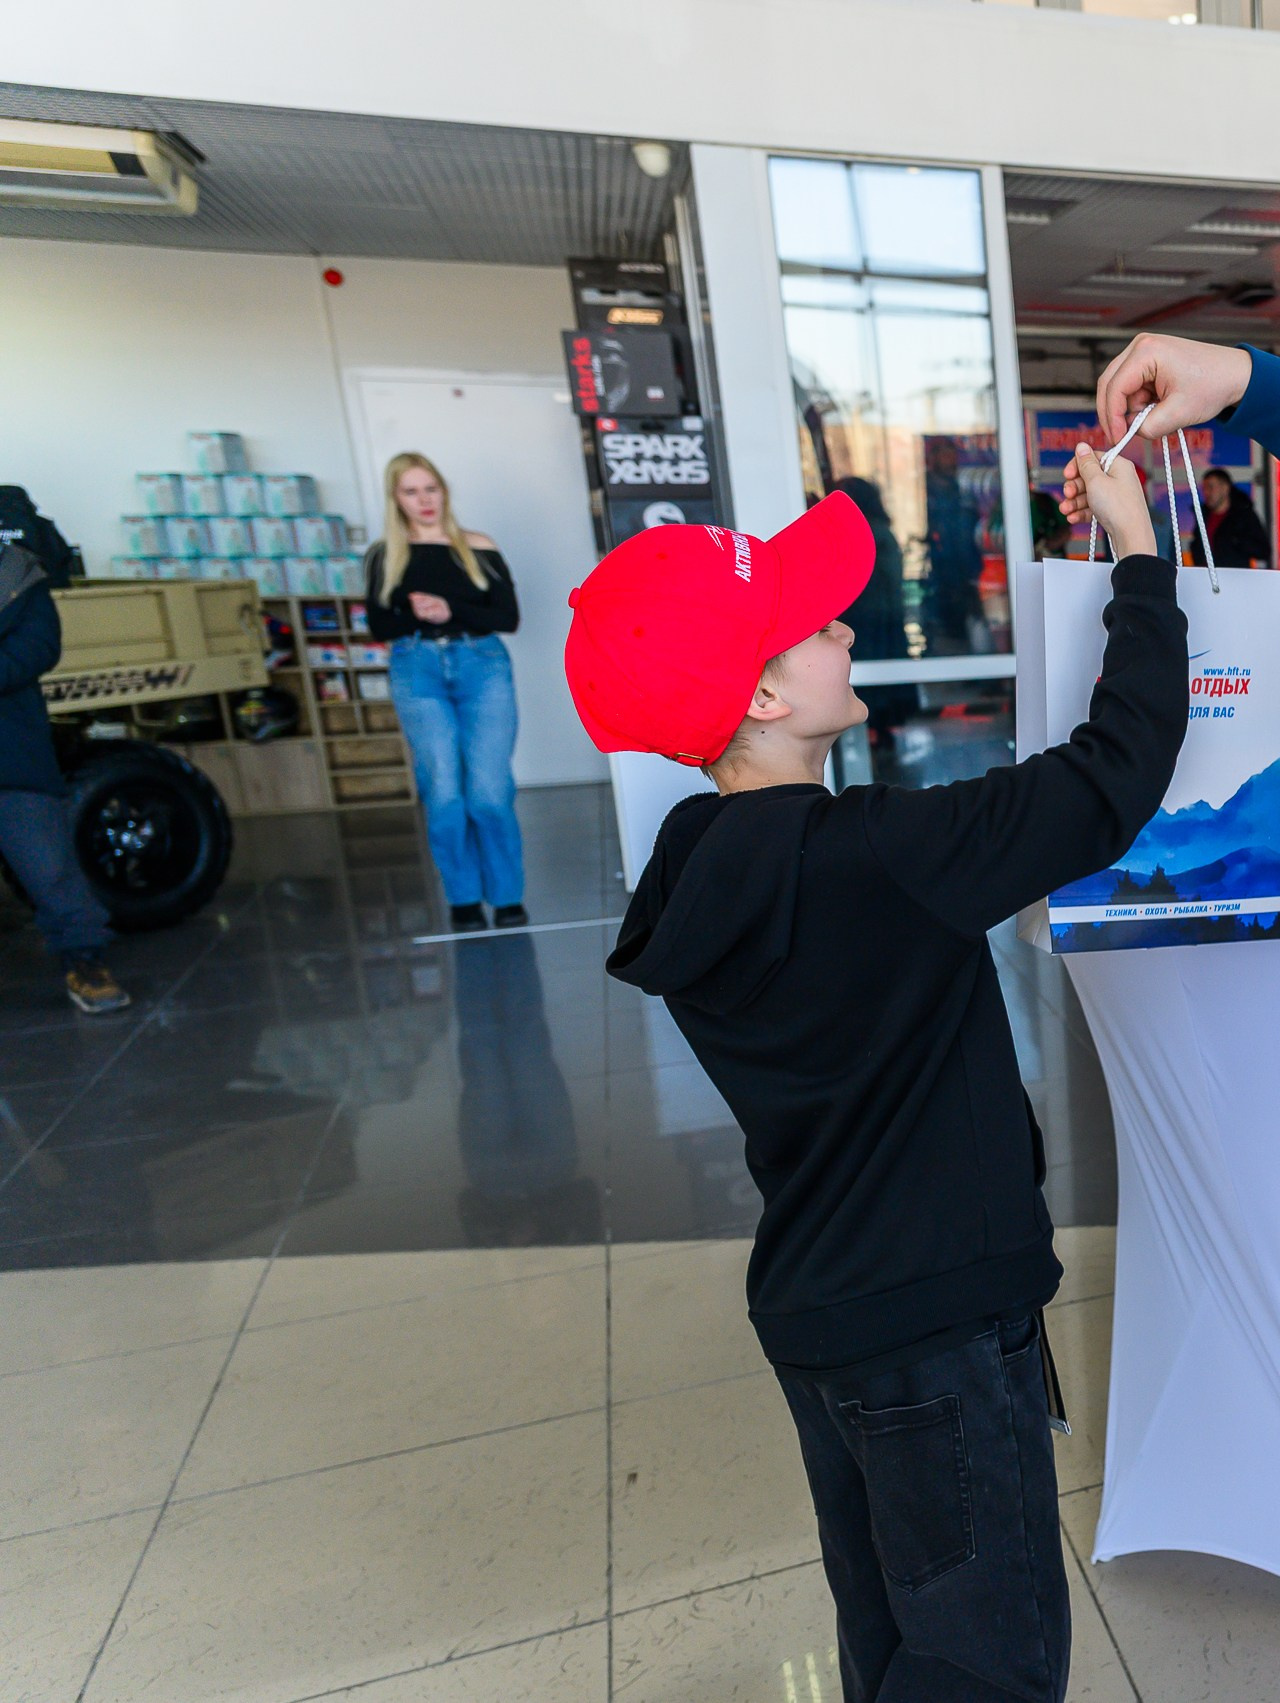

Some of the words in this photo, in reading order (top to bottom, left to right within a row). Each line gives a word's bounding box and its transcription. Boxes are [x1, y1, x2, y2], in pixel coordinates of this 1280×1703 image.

[603, 433, 707, 459] SPARX
[605, 459, 710, 485] SPARX
[1203, 666, 1251, 676] www.hft.ru
[1190, 677, 1251, 698] ОТДЫХ
[1212, 706, 1236, 718] ВАС
[1105, 908, 1138, 918] ТЕХНИКА
[1144, 907, 1168, 916] ОХОТА
[1173, 905, 1208, 915] РЫБАЛКА
[1213, 903, 1241, 912] ТУРИЗМ
